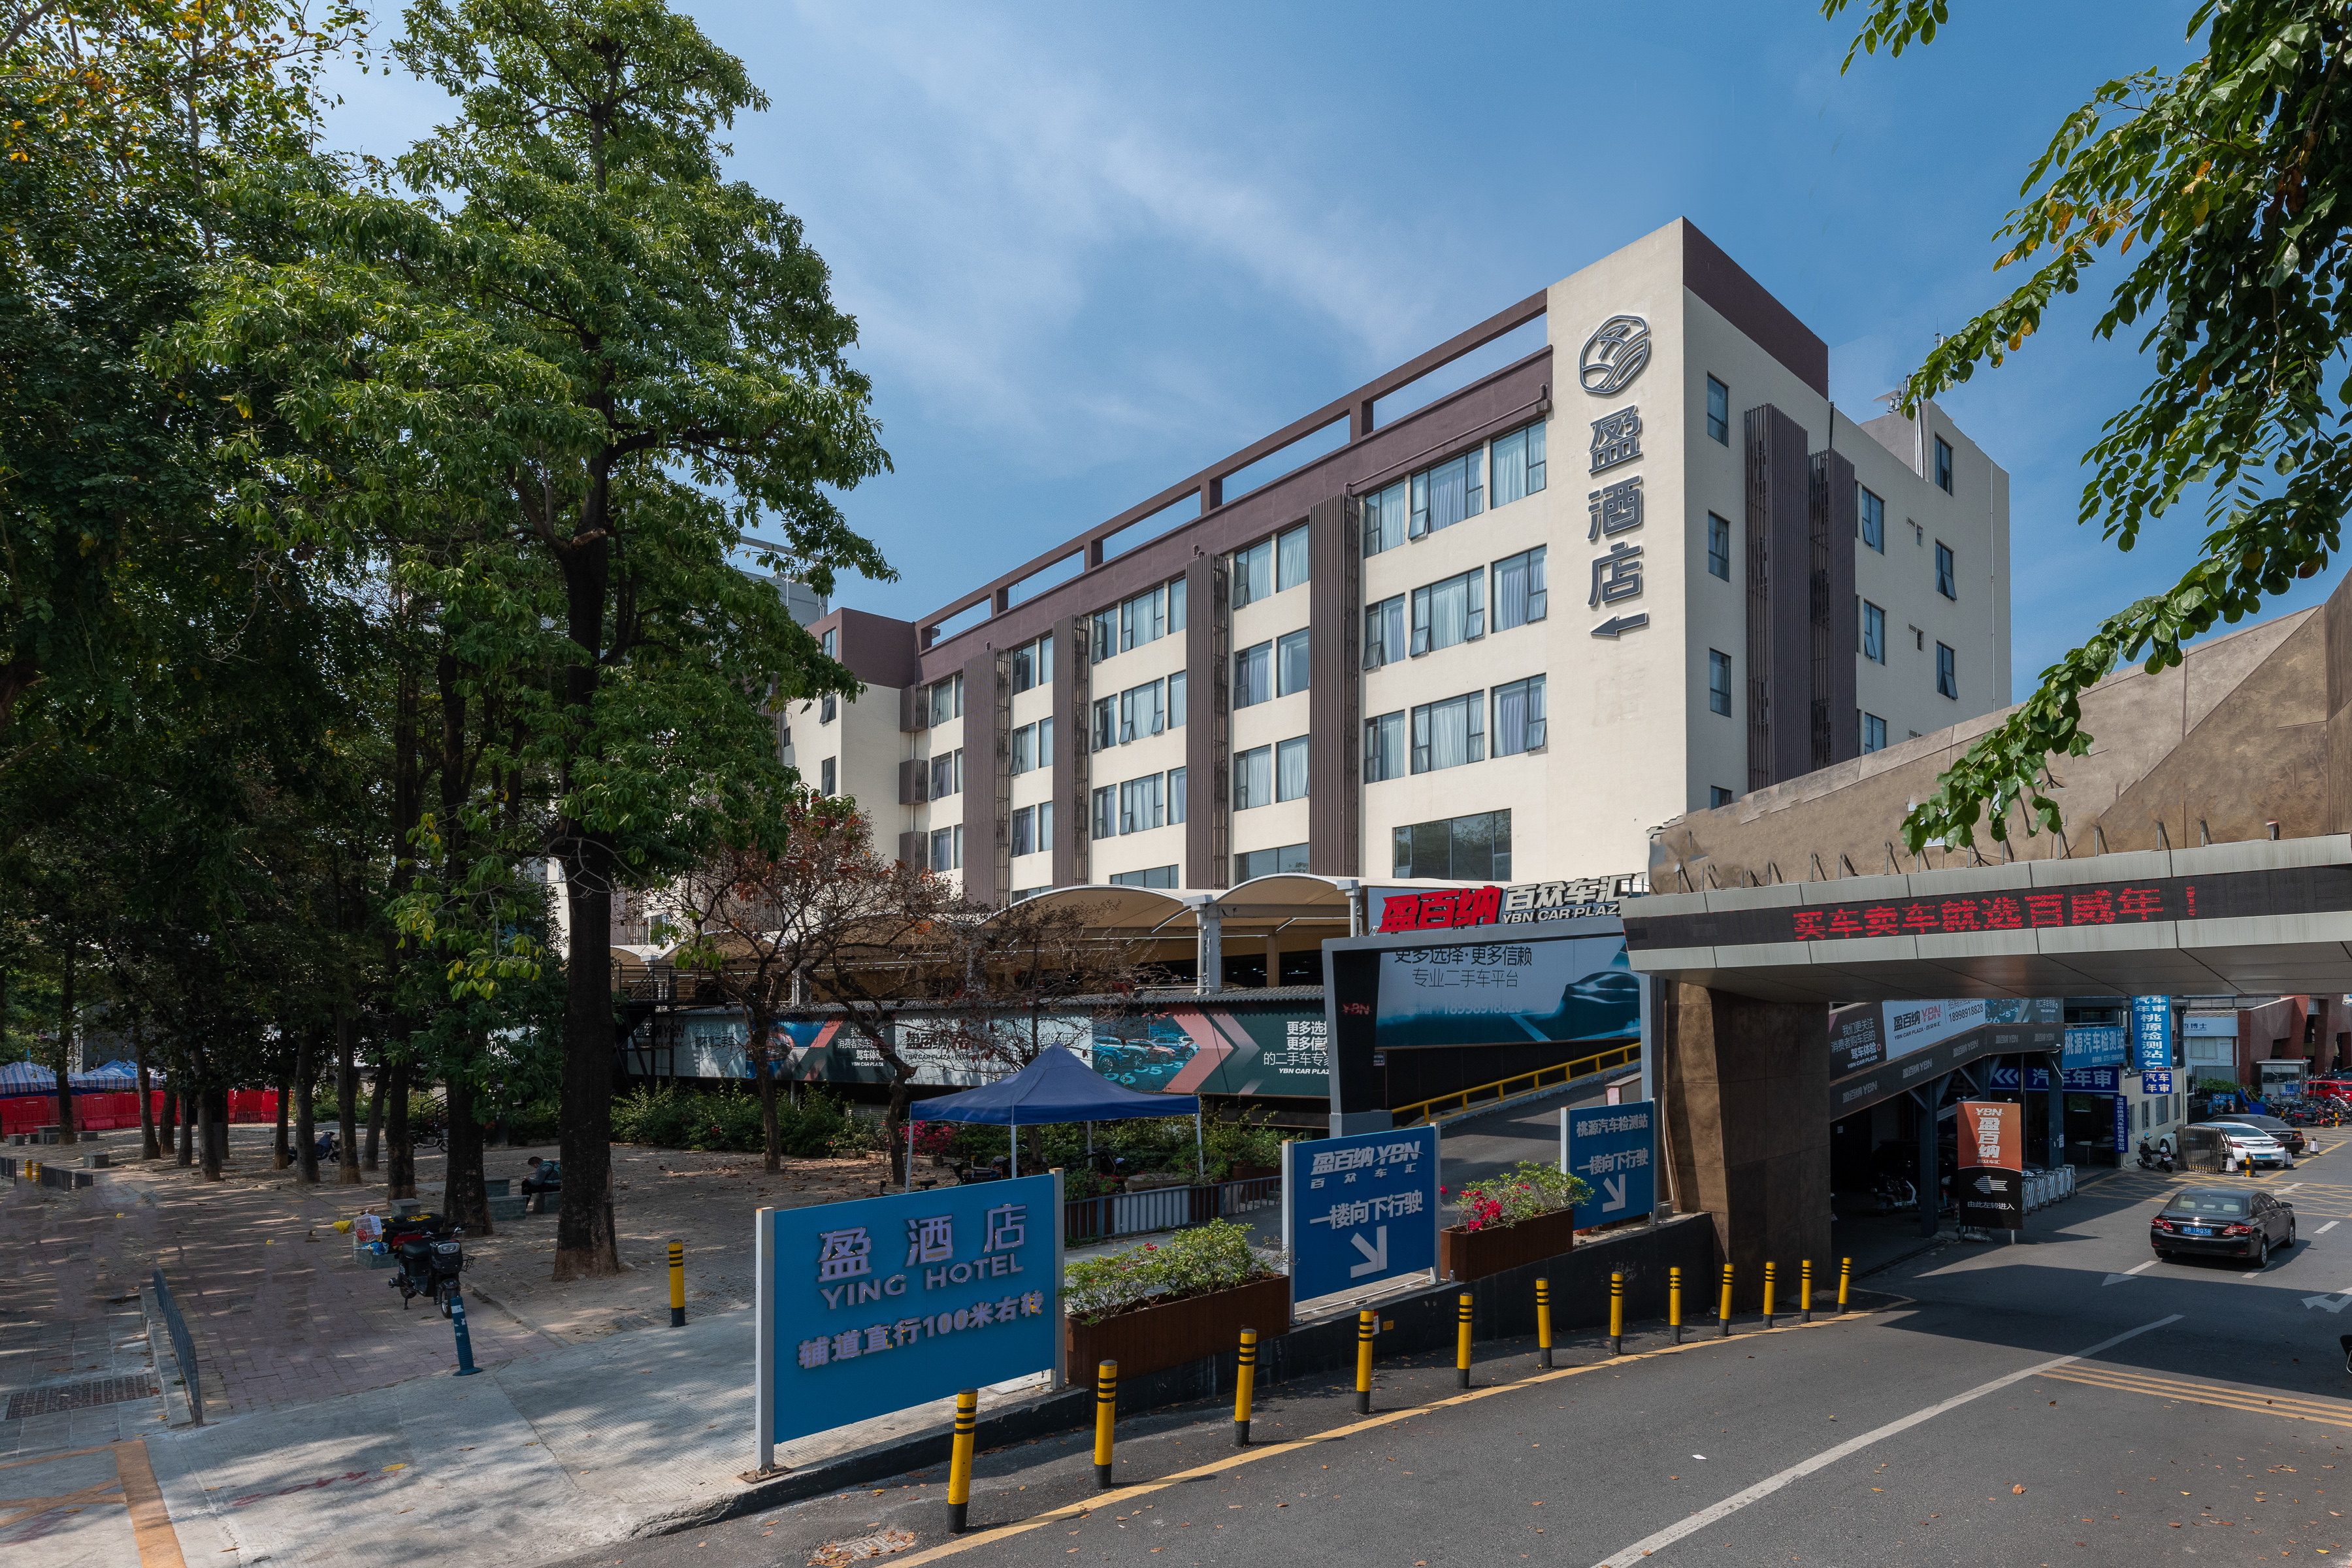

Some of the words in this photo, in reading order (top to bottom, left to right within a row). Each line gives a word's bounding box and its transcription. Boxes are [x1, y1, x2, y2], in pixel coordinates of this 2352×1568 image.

[1588, 404, 1642, 606] 盈酒店
[1379, 886, 1501, 933] 盈百纳
[1505, 874, 1635, 911] 百众车汇
[1503, 913, 1534, 924] YBN
[1538, 908, 1570, 921] CAR
[1413, 968, 1518, 988] 专业二手车平台
[1341, 1003, 1372, 1015] YBN
[1893, 1010, 1921, 1032] 盈百纳
[1921, 1004, 1941, 1022] YBN
[1949, 1004, 1983, 1022] 18998918828
[1842, 1017, 1874, 1037] 我们更关注
[2140, 1014, 2163, 1058] 桃源检测站
[1286, 1036, 1328, 1051] 更多信
[1831, 1030, 1876, 1053] 消费者购车后的
[1851, 1041, 1876, 1059] 驾车体验
[2065, 1030, 2124, 1055] 桃源汽车检测站
[857, 1049, 883, 1060] 驾车体验
[1903, 1065, 1919, 1079] 盈百纳
[1919, 1058, 1933, 1073] YBN
[2146, 1073, 2169, 1083] 汽车
[1842, 1086, 1862, 1103] 盈百纳
[1863, 1081, 1878, 1096] YBN
[2146, 1083, 2170, 1092] 年审
[1576, 1113, 1648, 1137] 桃源汽车检测站
[1978, 1117, 2001, 1158] 盈百纳
[1311, 1147, 1375, 1175] 盈百纳
[1376, 1141, 1421, 1164] YBN
[1576, 1147, 1648, 1176] 一楼向下行驶
[1311, 1164, 1416, 1189] 百众车汇
[1309, 1189, 1423, 1229] 一楼向下行驶
[1967, 1201, 2015, 1210] 由此左转进入
[818, 1203, 1028, 1282] 盈酒店
[821, 1274, 907, 1311] YING
[926, 1253, 1024, 1290] HOTEL
[798, 1290, 1044, 1369] 辅道直行100米右转
